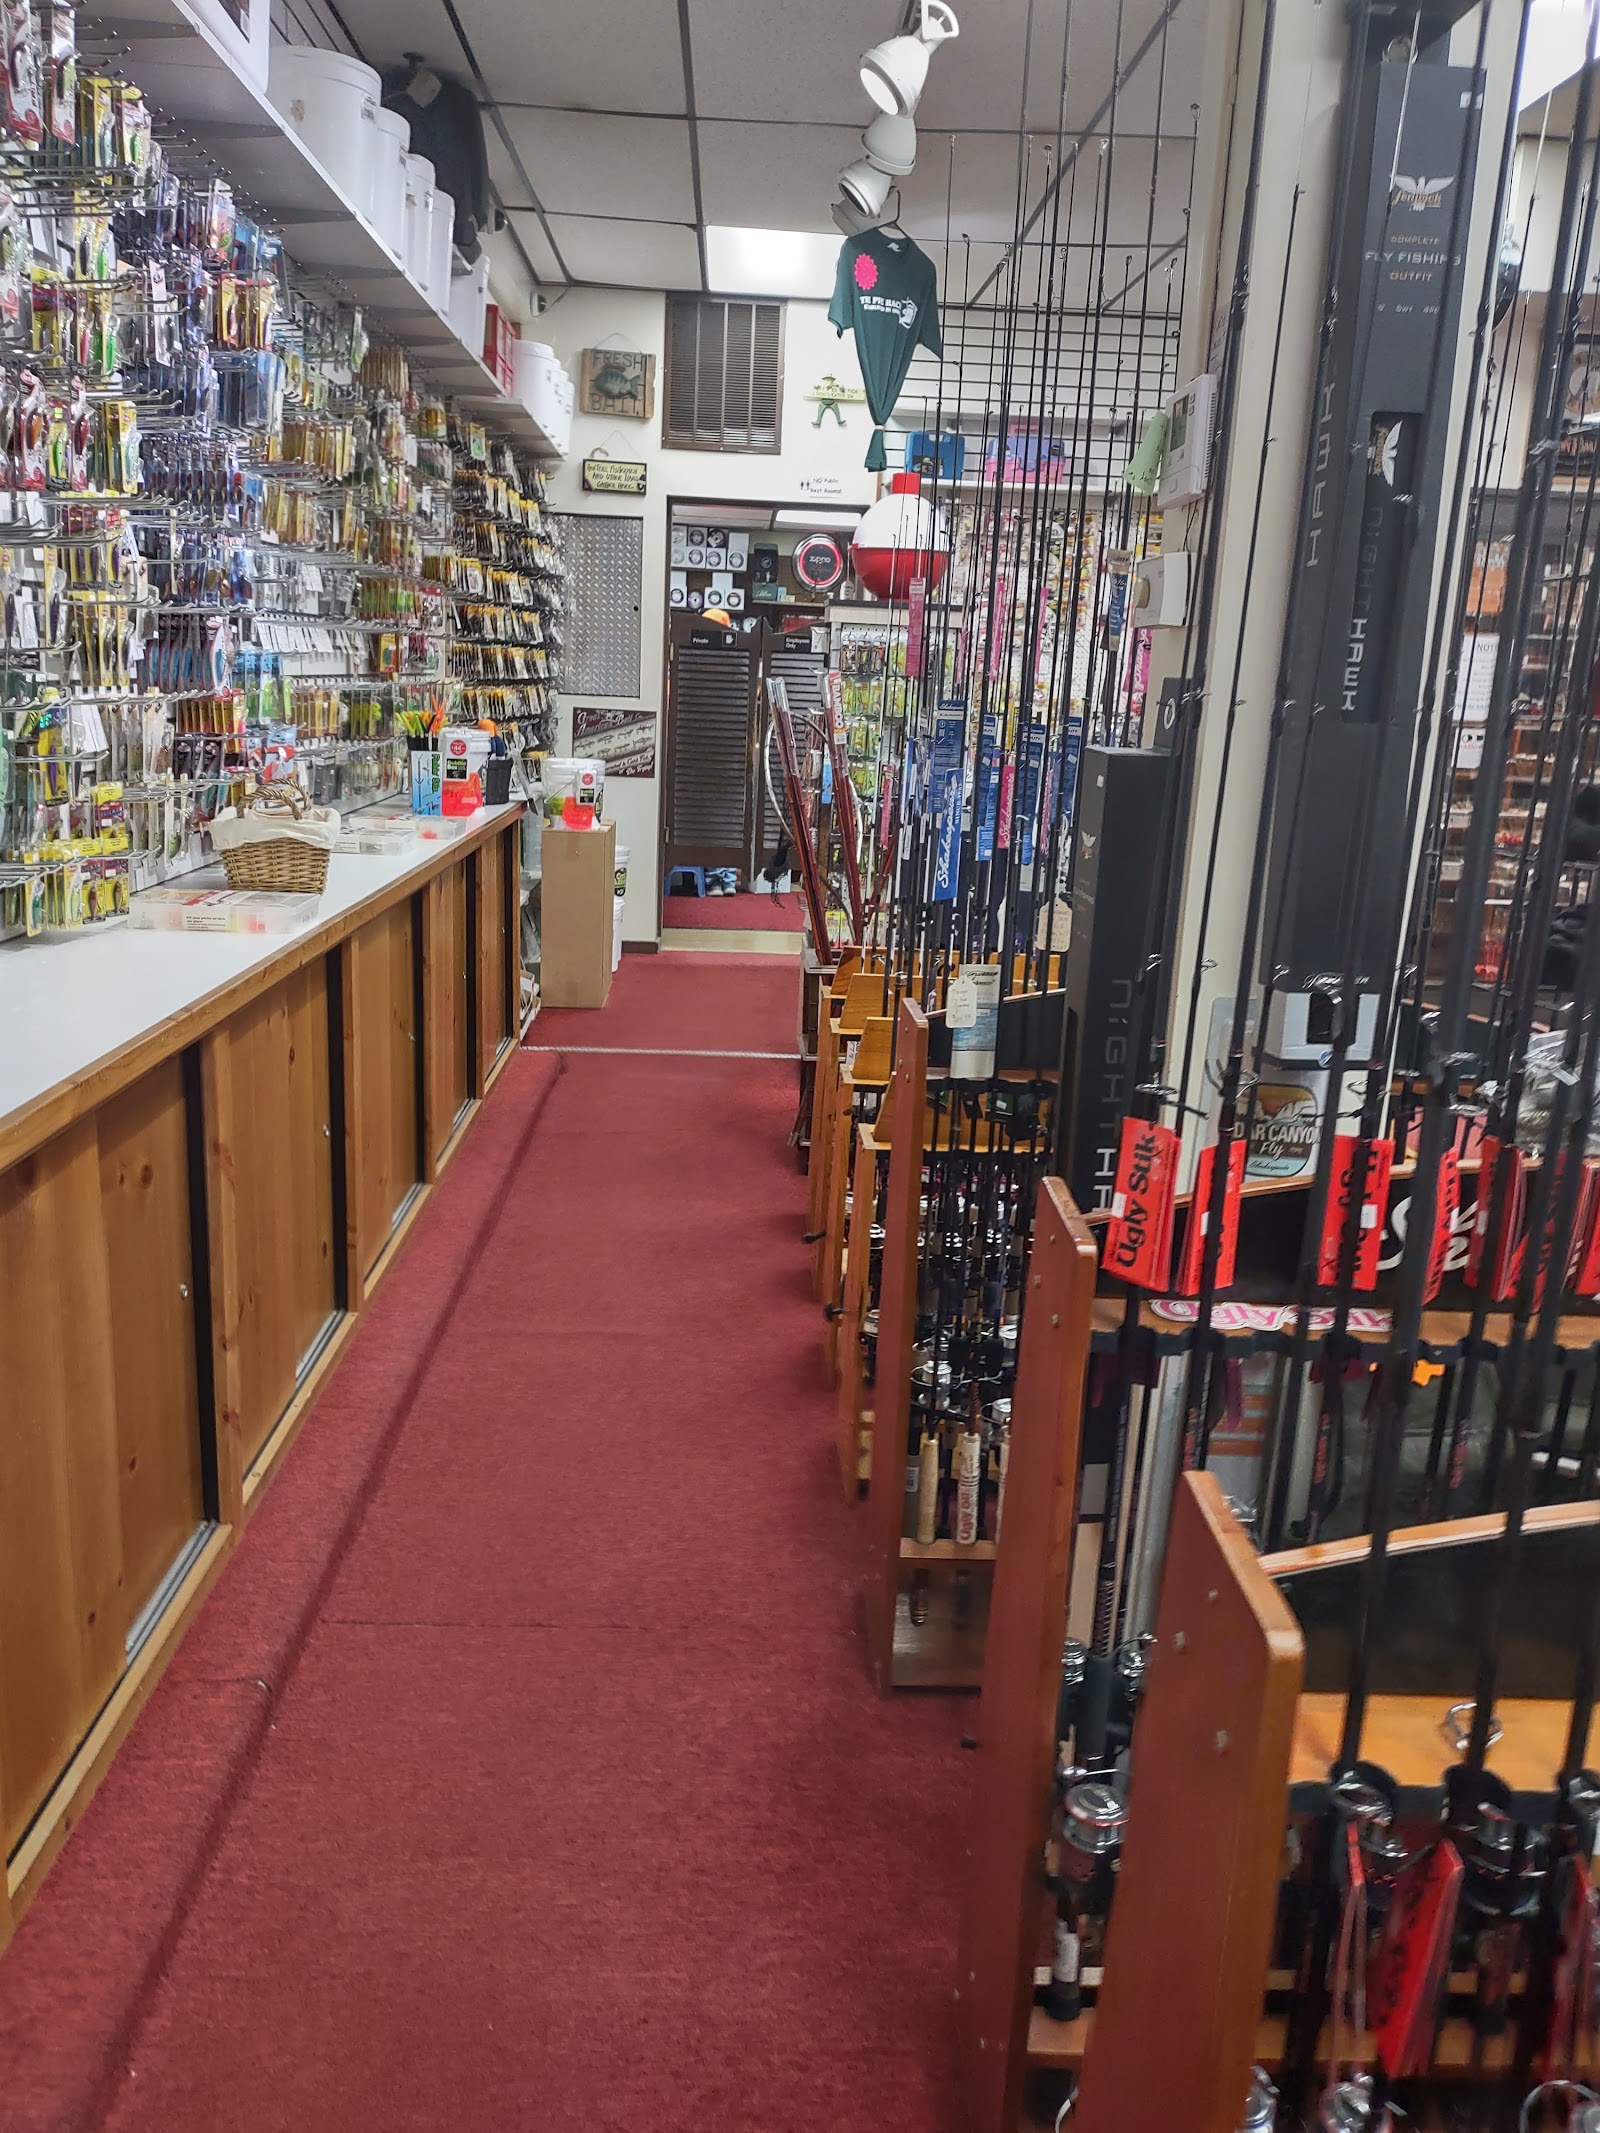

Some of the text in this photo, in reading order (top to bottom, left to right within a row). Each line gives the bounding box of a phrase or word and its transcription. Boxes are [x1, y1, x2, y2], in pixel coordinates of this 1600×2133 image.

[1391, 235, 1440, 245] COMPLETE
[1365, 251, 1394, 262] FLY
[1390, 271, 1432, 281] OUTFIT
[592, 351, 643, 372] FRESH
[591, 392, 640, 414] BAIT
[785, 637, 810, 645] Employees
[832, 685, 844, 729] BAMBOO
[1268, 1123, 1322, 1144] CANYON
[1259, 1142, 1285, 1161] Fly
[1117, 1133, 1156, 1268] Ugly Stik
